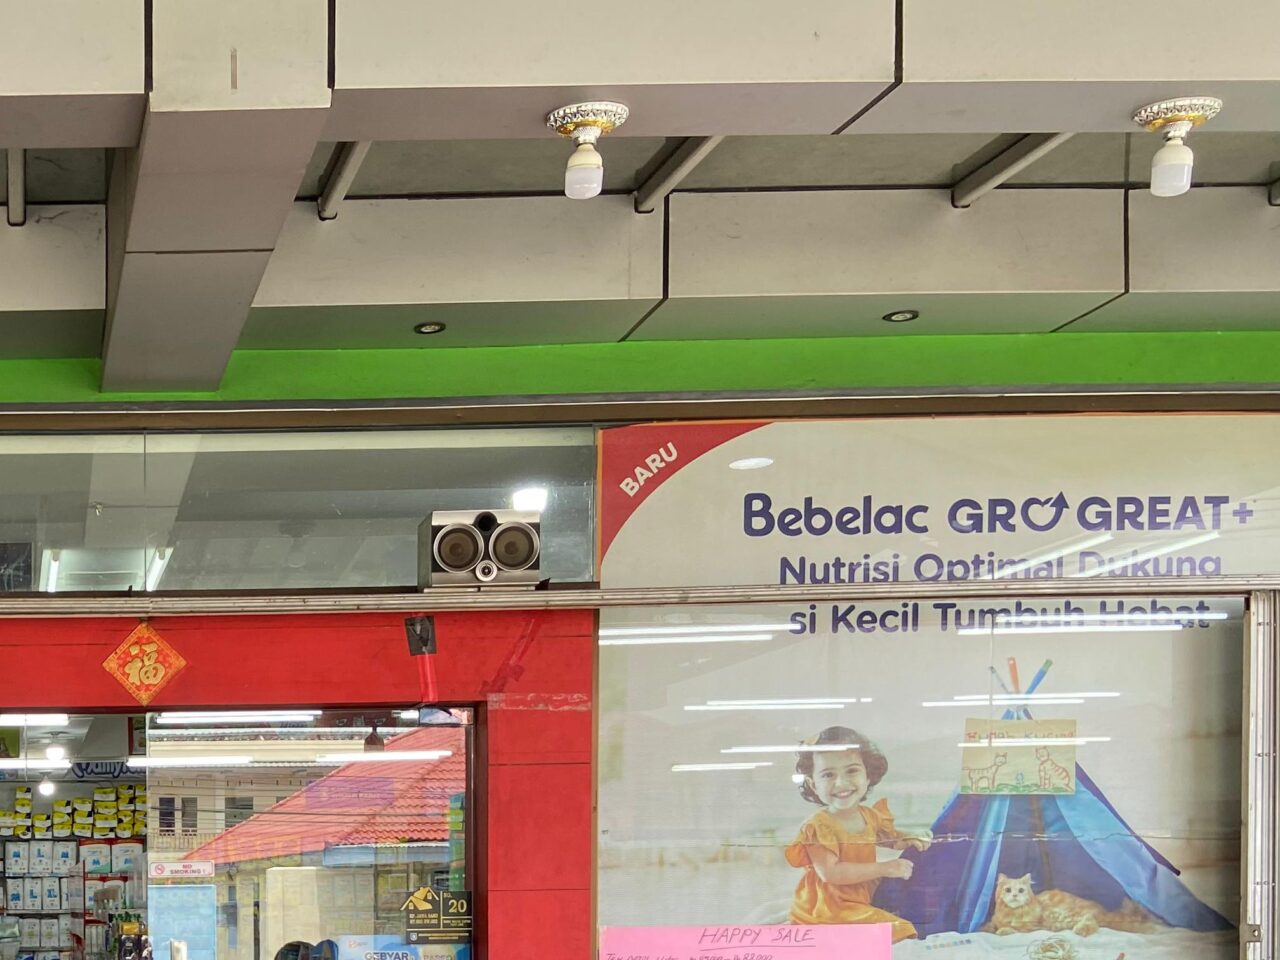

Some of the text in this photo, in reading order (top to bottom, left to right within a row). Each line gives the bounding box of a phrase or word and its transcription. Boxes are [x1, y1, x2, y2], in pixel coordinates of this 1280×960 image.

[619, 441, 678, 498] BARU
[742, 492, 929, 536] Bebelac
[1077, 495, 1254, 532] GREAT+
[780, 551, 1222, 583] Nutrisi Optimal Dukung
[789, 604, 817, 634] si
[832, 602, 919, 633] Kecil
[933, 601, 1084, 632] Tumbuh
[124, 642, 166, 686] 福
[448, 899, 468, 913] 20
[698, 927, 816, 944] HAPPY SALE
[365, 951, 409, 960] GEBYAR
